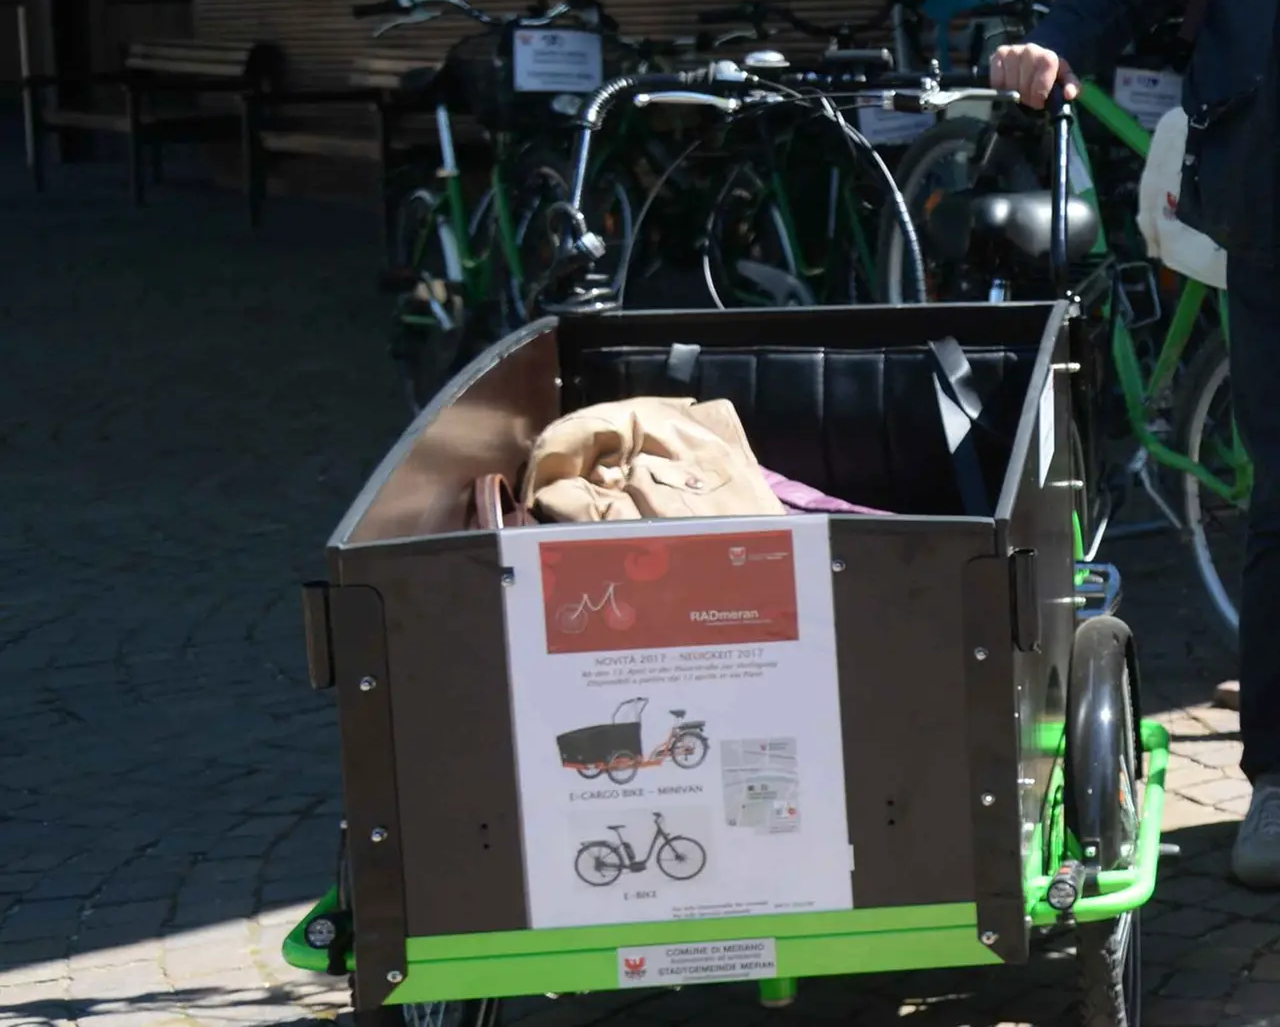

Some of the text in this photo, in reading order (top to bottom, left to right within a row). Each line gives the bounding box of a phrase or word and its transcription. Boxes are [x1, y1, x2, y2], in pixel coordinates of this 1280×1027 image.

[690, 609, 759, 622] RADmeran
[657, 785, 704, 795] MINIVAN
[666, 948, 708, 957] COMUNE
[723, 943, 765, 953] MERANO
[658, 961, 775, 976] STADTGEMEINDE MERAN
